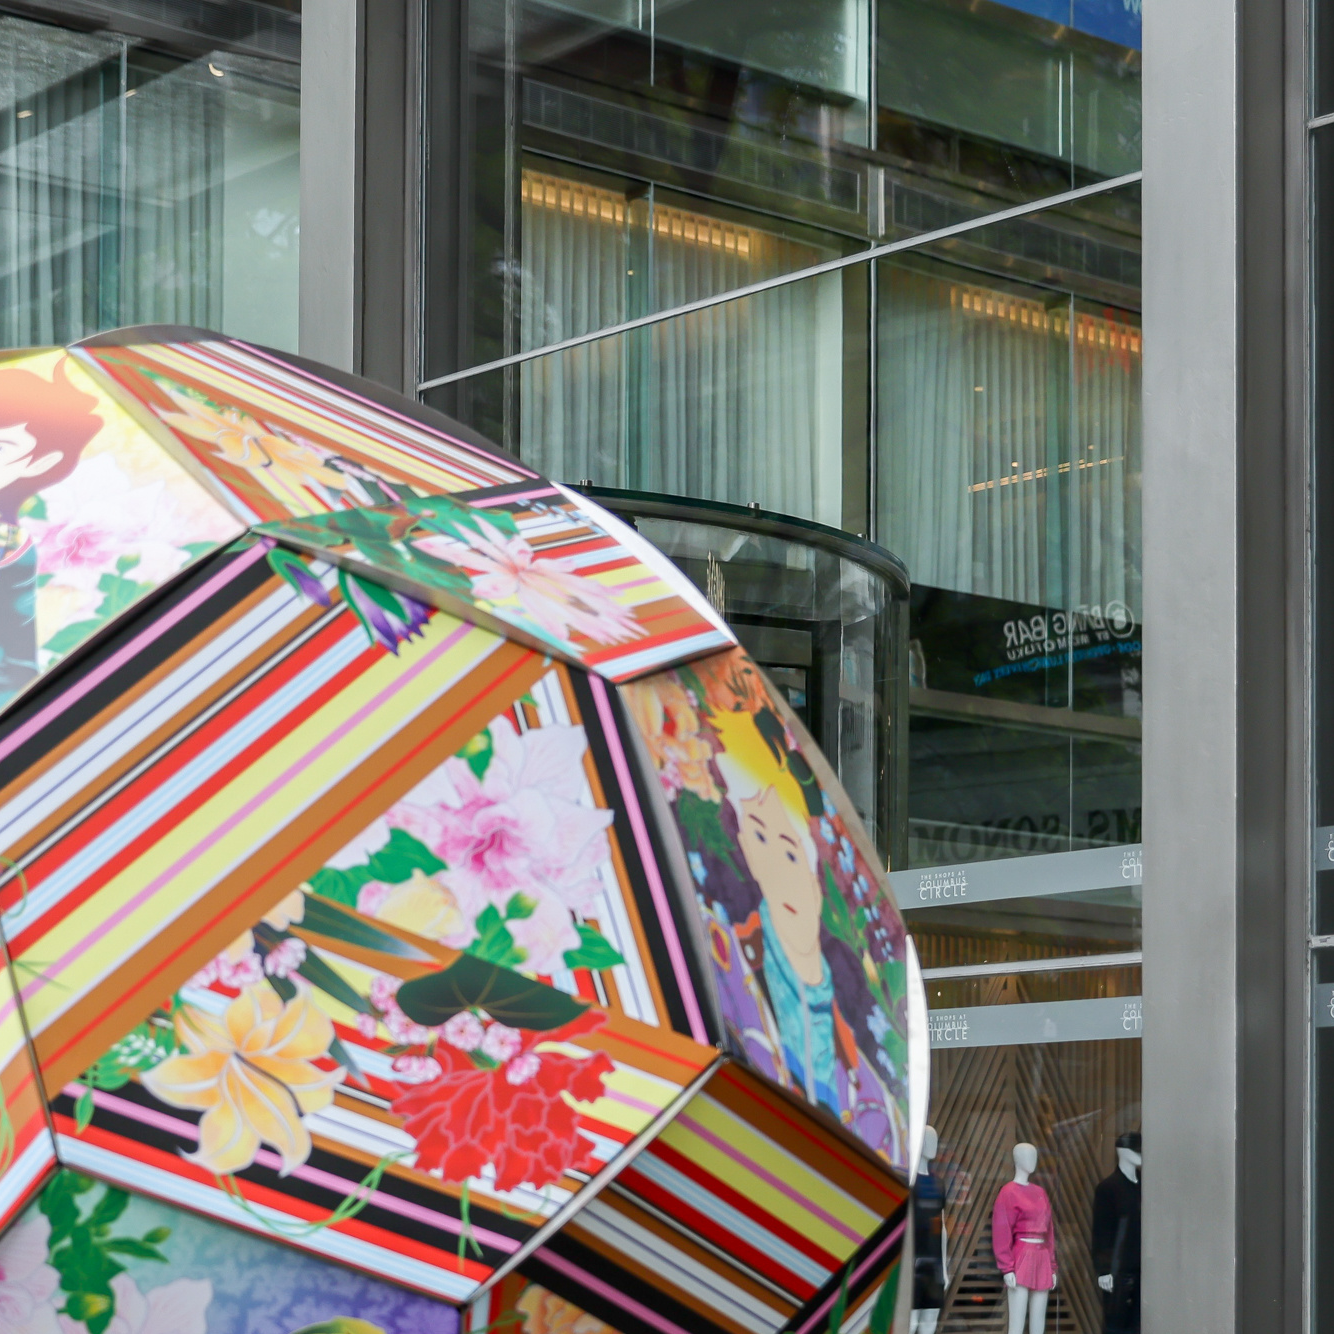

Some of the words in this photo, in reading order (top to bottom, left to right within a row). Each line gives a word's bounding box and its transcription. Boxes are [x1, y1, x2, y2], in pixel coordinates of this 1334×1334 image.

[919, 876, 966, 889] COLUMBUS
[919, 884, 966, 900] CIRCLE
[928, 1020, 967, 1030] OLUMBUS
[931, 1028, 967, 1042] IRCLE
